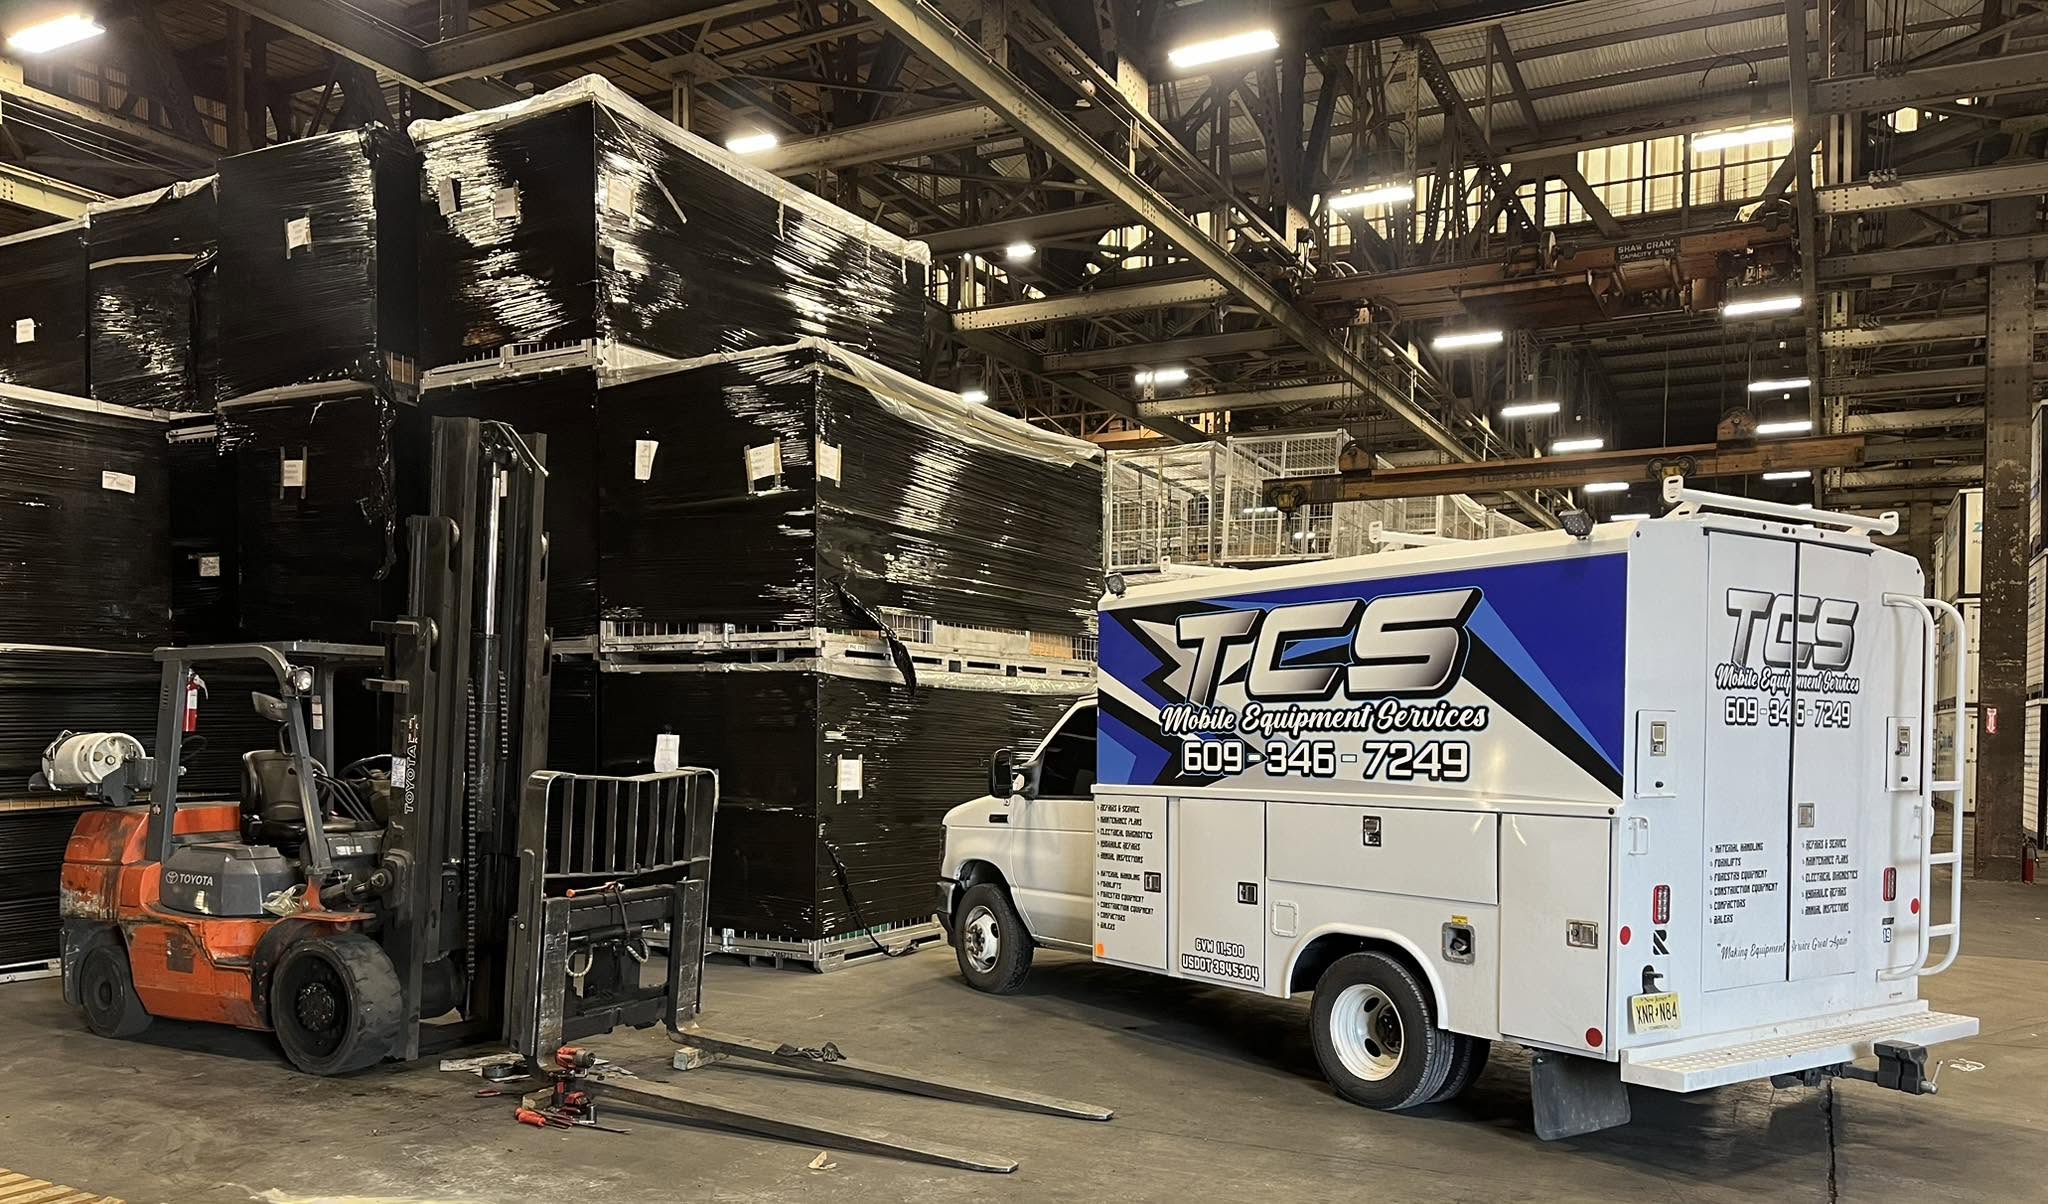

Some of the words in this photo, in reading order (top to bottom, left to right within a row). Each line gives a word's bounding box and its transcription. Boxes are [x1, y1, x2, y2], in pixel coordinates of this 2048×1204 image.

[1618, 244, 1642, 254] SHAW
[1646, 239, 1676, 250] CRAN
[1620, 250, 1652, 260] CAPACITY
[1727, 588, 1859, 671] TCS
[1175, 586, 1484, 707] TCS
[1715, 663, 1759, 690] Mobile
[1759, 665, 1822, 696] Equipment
[1822, 668, 1860, 694] Services
[1159, 703, 1236, 736] Mobile
[1240, 702, 1374, 739] Equipment
[1374, 697, 1489, 734] Services
[404, 745, 417, 814] TOYOTA
[1715, 844, 1739, 853] MATERIAL
[1740, 842, 1764, 852] HANDLING
[1829, 839, 1847, 848] SERVICE
[1714, 857, 1741, 867] FORKLIFTS
[1805, 855, 1834, 866] MAINTENANCE
[1835, 854, 1848, 864] PLANS
[180, 873, 213, 886] TOYOTA
[1714, 872, 1740, 882] FORESTRY
[1741, 869, 1767, 881] EQUIPMENT
[1805, 872, 1831, 882] ELECTRICAL
[1832, 870, 1858, 880] DIAGNOSTICS
[1714, 885, 1750, 896] CONSTRUCTION
[1752, 882, 1778, 894] EQUIPMENT
[1714, 899, 1746, 910] COMPACTORS
[1822, 903, 1849, 914] INSPECTIONS
[1714, 914, 1733, 924] BALERS
[1195, 937, 1214, 953] GVW
[1750, 942, 1785, 959] Equipment
[1811, 938, 1828, 950] Great
[1182, 953, 1212, 973] USDOT
[1212, 959, 1260, 981] 3945304
